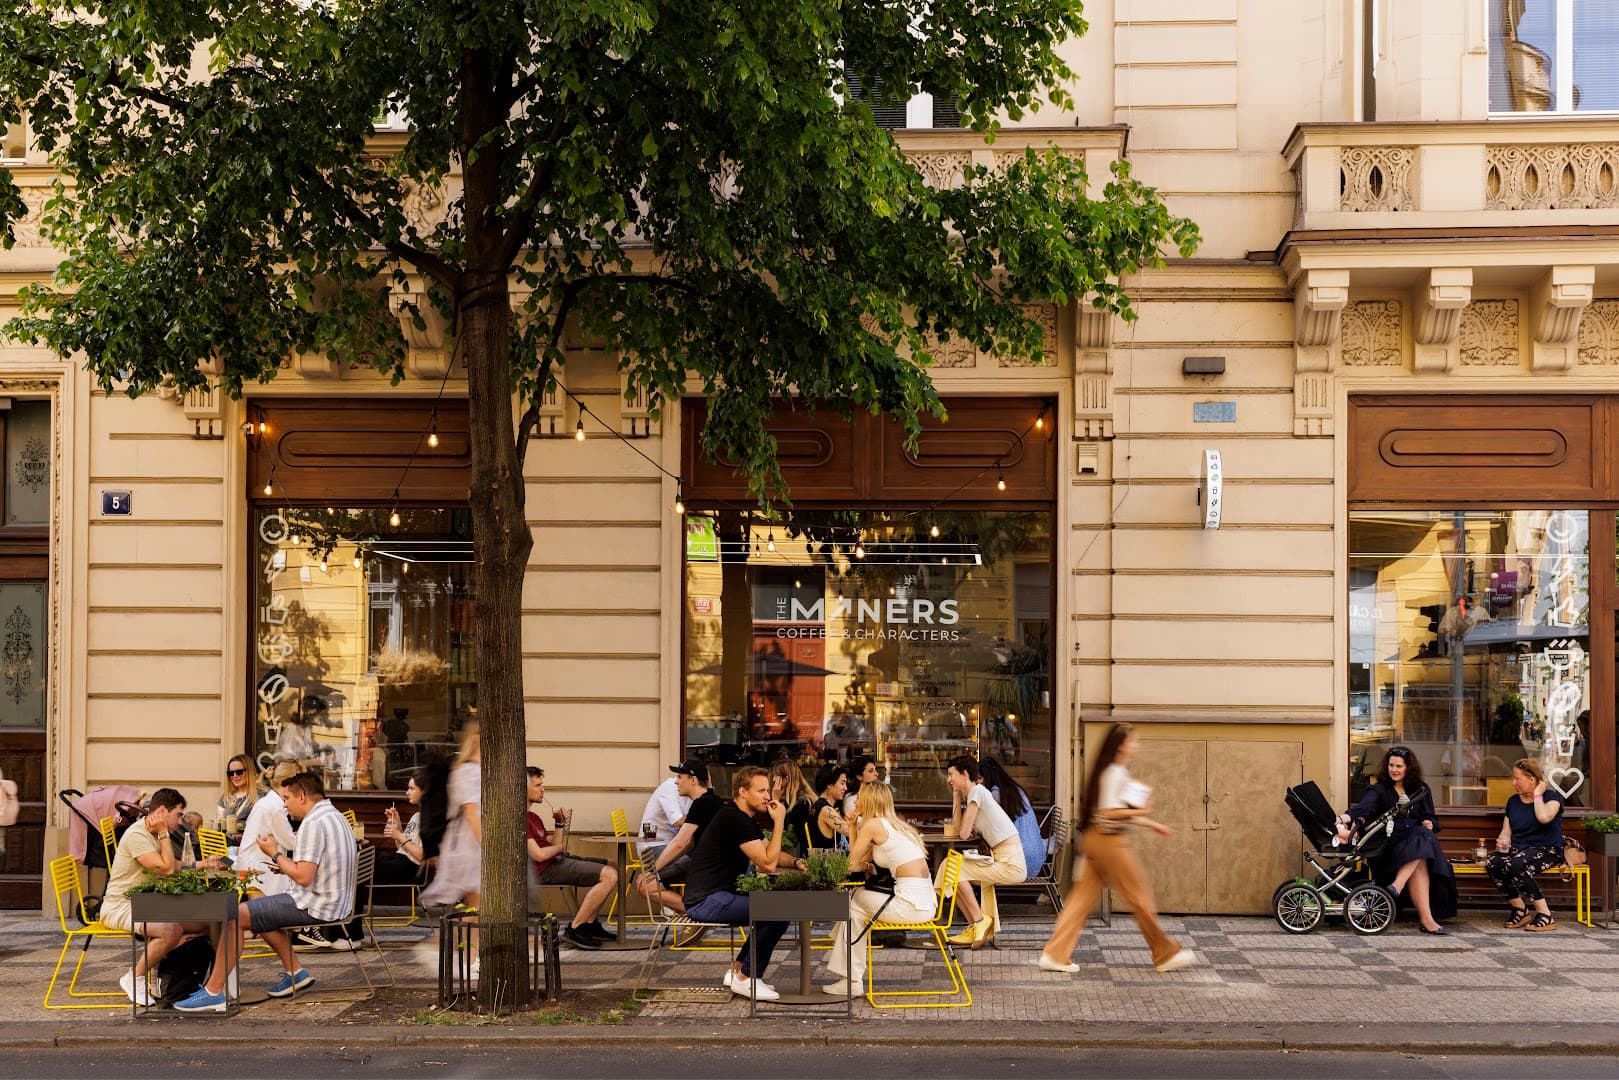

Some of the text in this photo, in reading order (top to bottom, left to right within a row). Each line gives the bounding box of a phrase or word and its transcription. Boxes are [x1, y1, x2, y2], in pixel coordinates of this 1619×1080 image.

[112, 496, 120, 510] 5
[776, 597, 787, 621] THE
[842, 628, 851, 641] &
[854, 629, 960, 641] CHARACTERS
